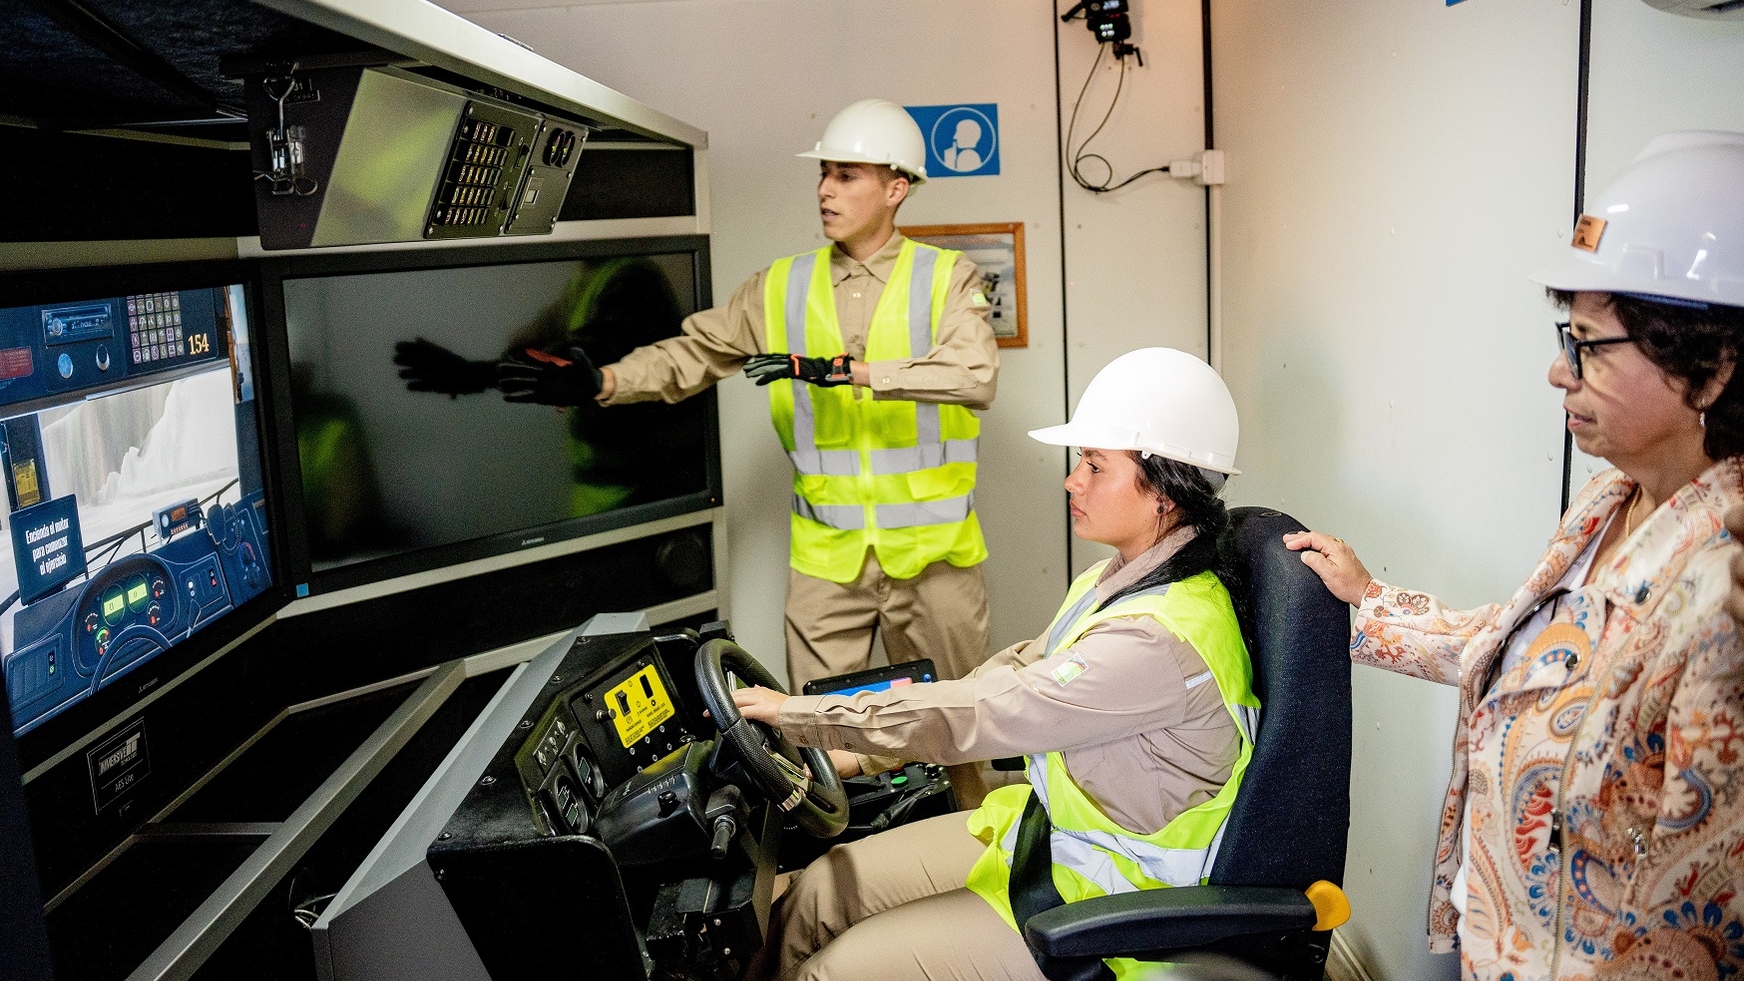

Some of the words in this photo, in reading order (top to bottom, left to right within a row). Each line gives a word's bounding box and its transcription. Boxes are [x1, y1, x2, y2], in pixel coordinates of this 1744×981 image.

[188, 332, 210, 355] 154
[25, 524, 49, 545] Encienda
[49, 520, 54, 535] el
[54, 517, 69, 533] motor
[32, 544, 45, 563] para
[45, 535, 68, 554] comenzar
[39, 560, 45, 576] el
[45, 552, 67, 574] ejercicio
